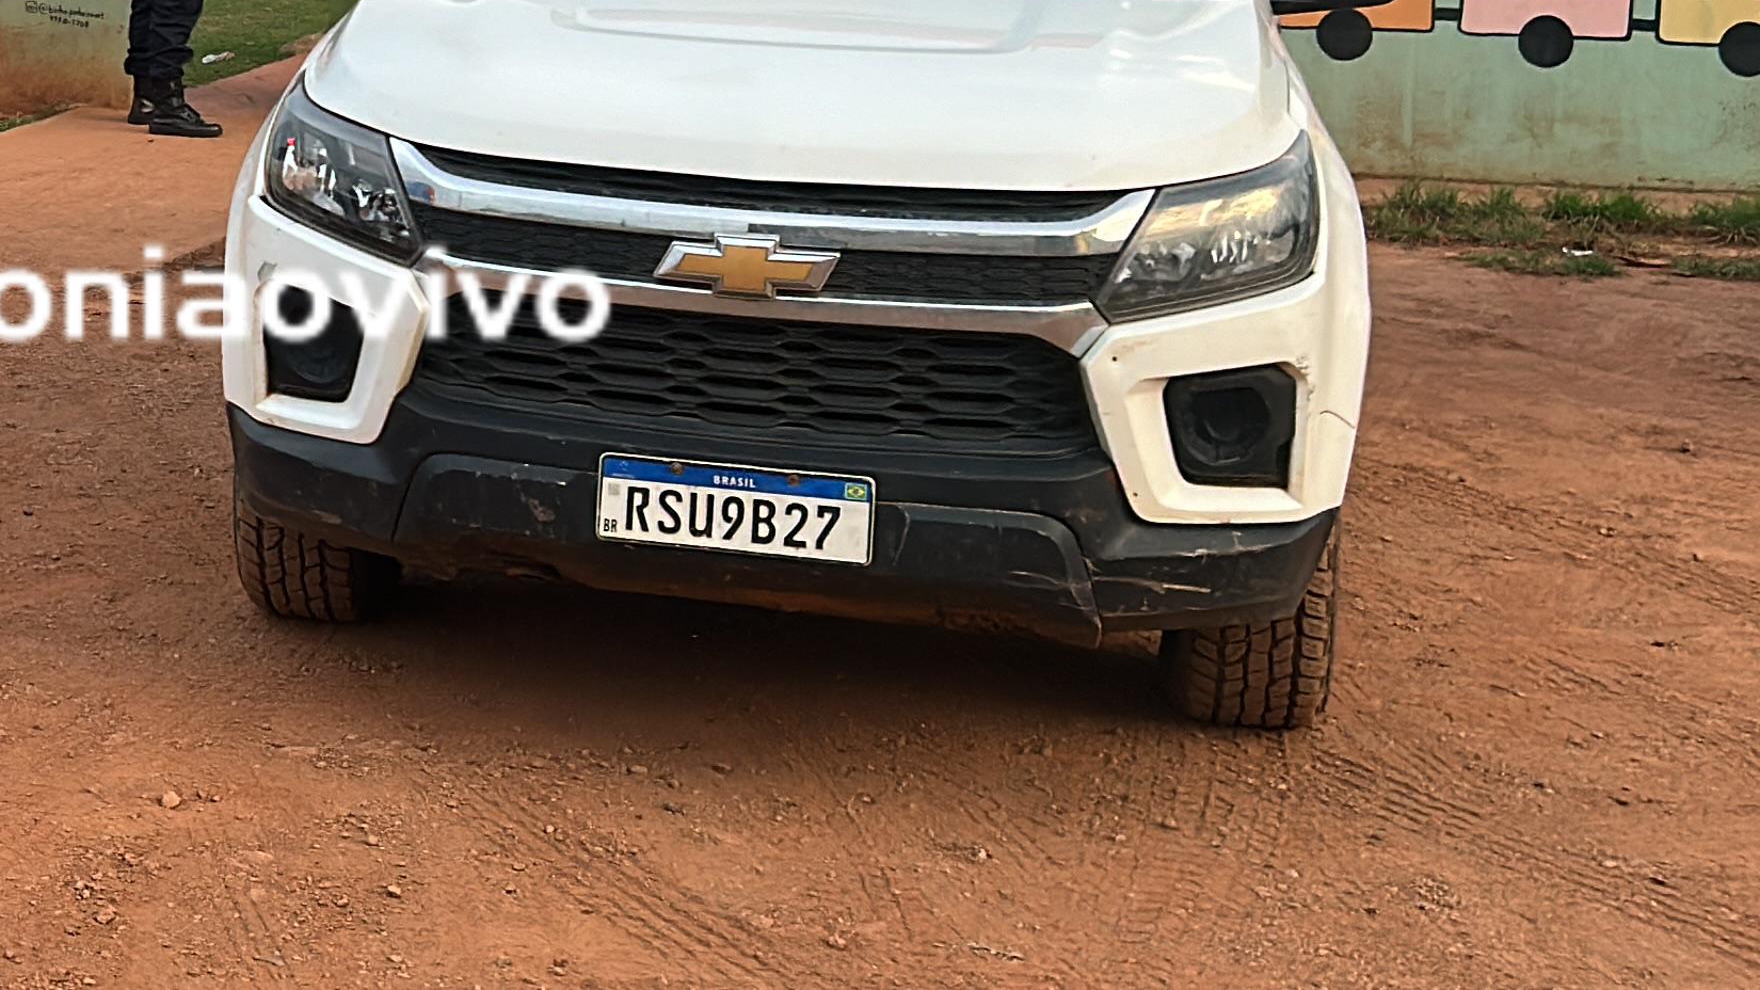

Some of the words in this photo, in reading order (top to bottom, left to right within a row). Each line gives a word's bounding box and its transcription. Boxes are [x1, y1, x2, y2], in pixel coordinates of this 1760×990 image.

[713, 475, 756, 488] BRASIL
[603, 517, 617, 533] BR
[625, 486, 841, 550] RSU9B27
